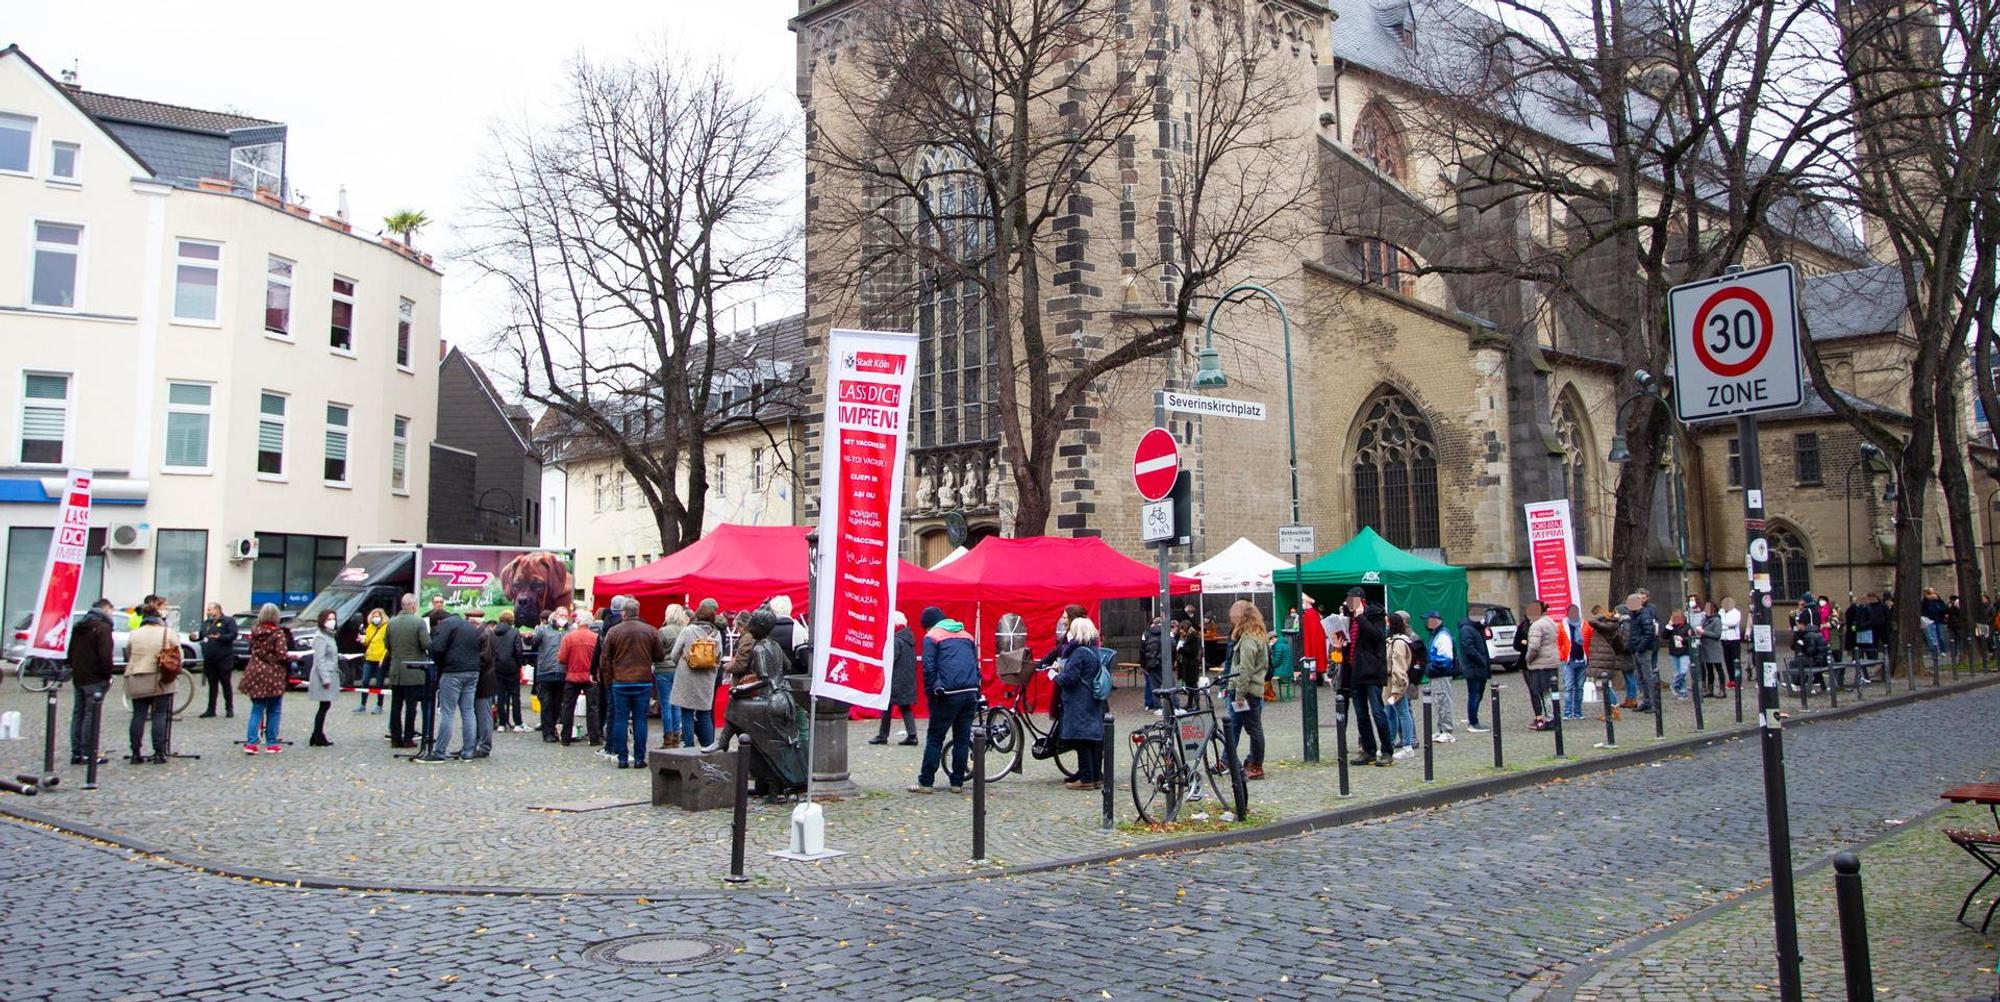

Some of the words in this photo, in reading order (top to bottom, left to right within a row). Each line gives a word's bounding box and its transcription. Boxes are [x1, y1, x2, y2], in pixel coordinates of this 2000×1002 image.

[1709, 309, 1756, 354] 30
[856, 358, 873, 368] Stadt
[873, 358, 890, 369] Köln
[839, 384, 866, 400] LASS
[868, 386, 900, 405] DICH
[1707, 378, 1768, 407] ZONE
[1169, 394, 1261, 416] Severinskirchplatz
[839, 405, 899, 429] IMPFEN!
[1361, 571, 1381, 581] AOK
